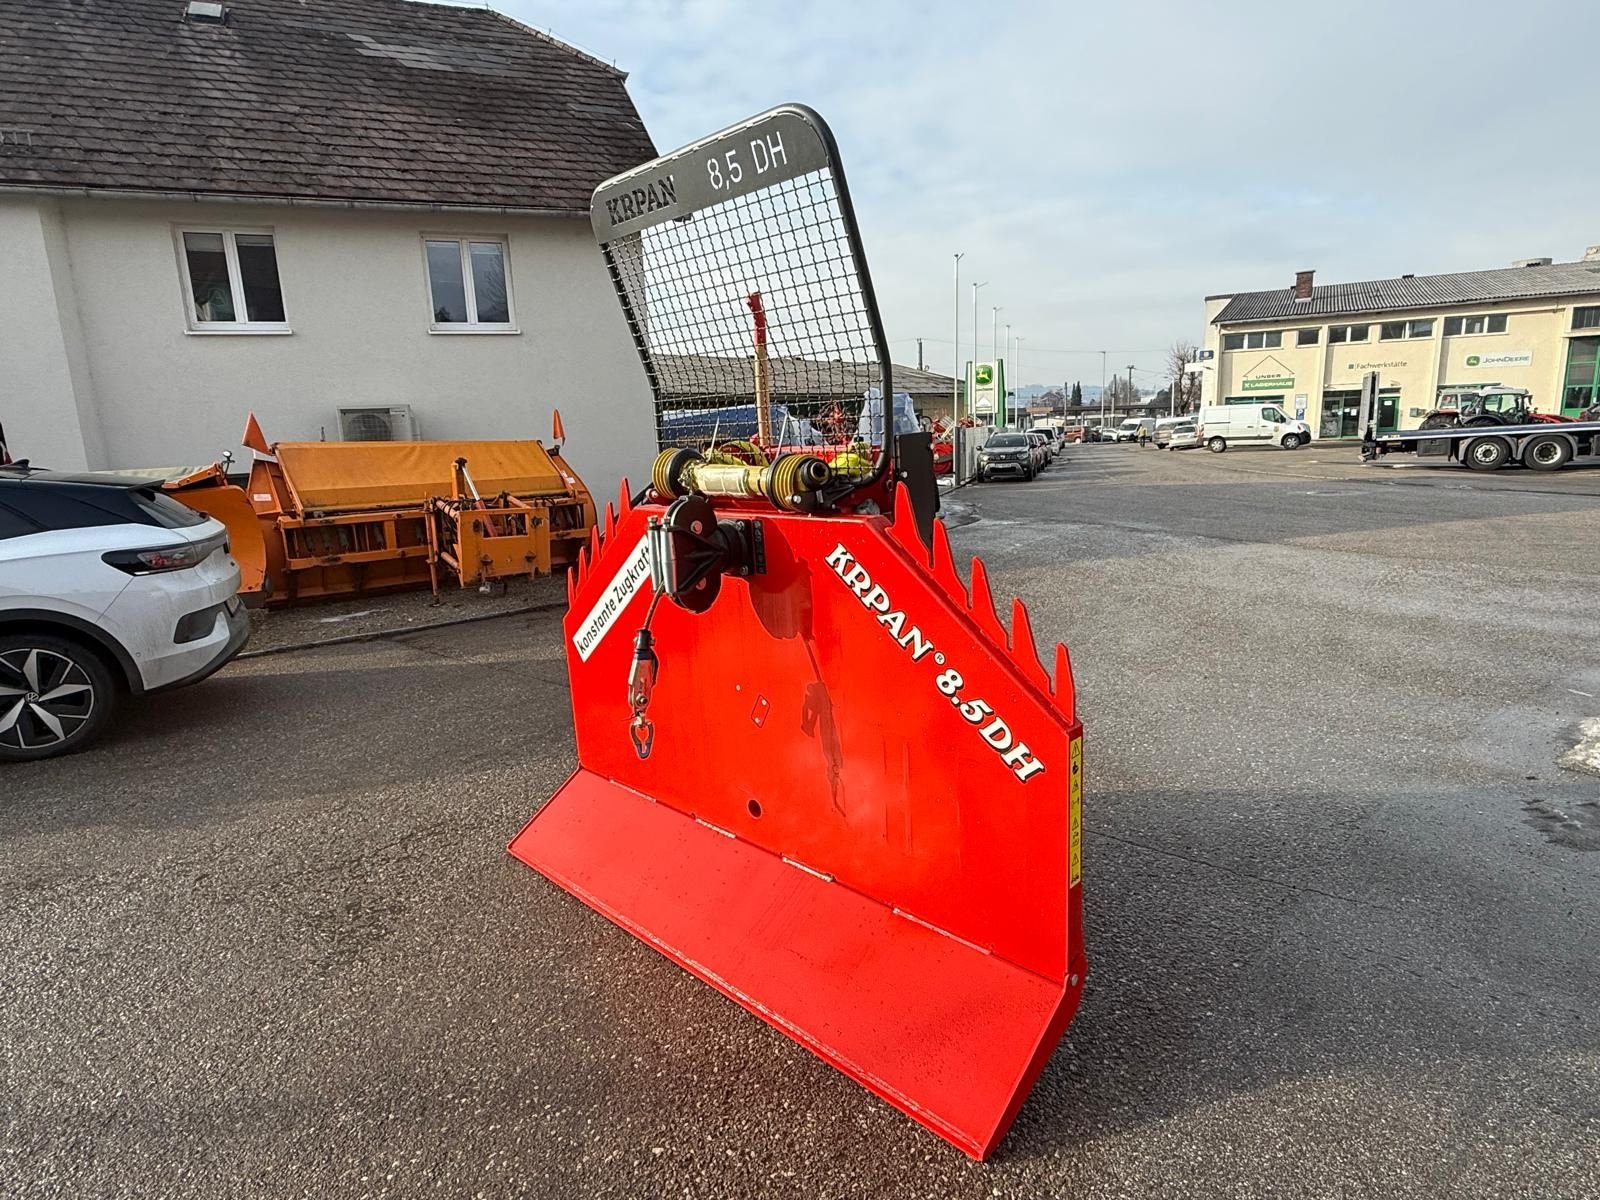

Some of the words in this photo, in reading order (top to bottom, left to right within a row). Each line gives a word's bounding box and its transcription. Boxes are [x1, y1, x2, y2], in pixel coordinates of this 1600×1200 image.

[605, 175, 678, 226] KRPAN
[707, 150, 743, 191] 8,5
[750, 131, 788, 175] DH
[577, 598, 617, 654] konstante
[824, 543, 934, 663] KRPAN
